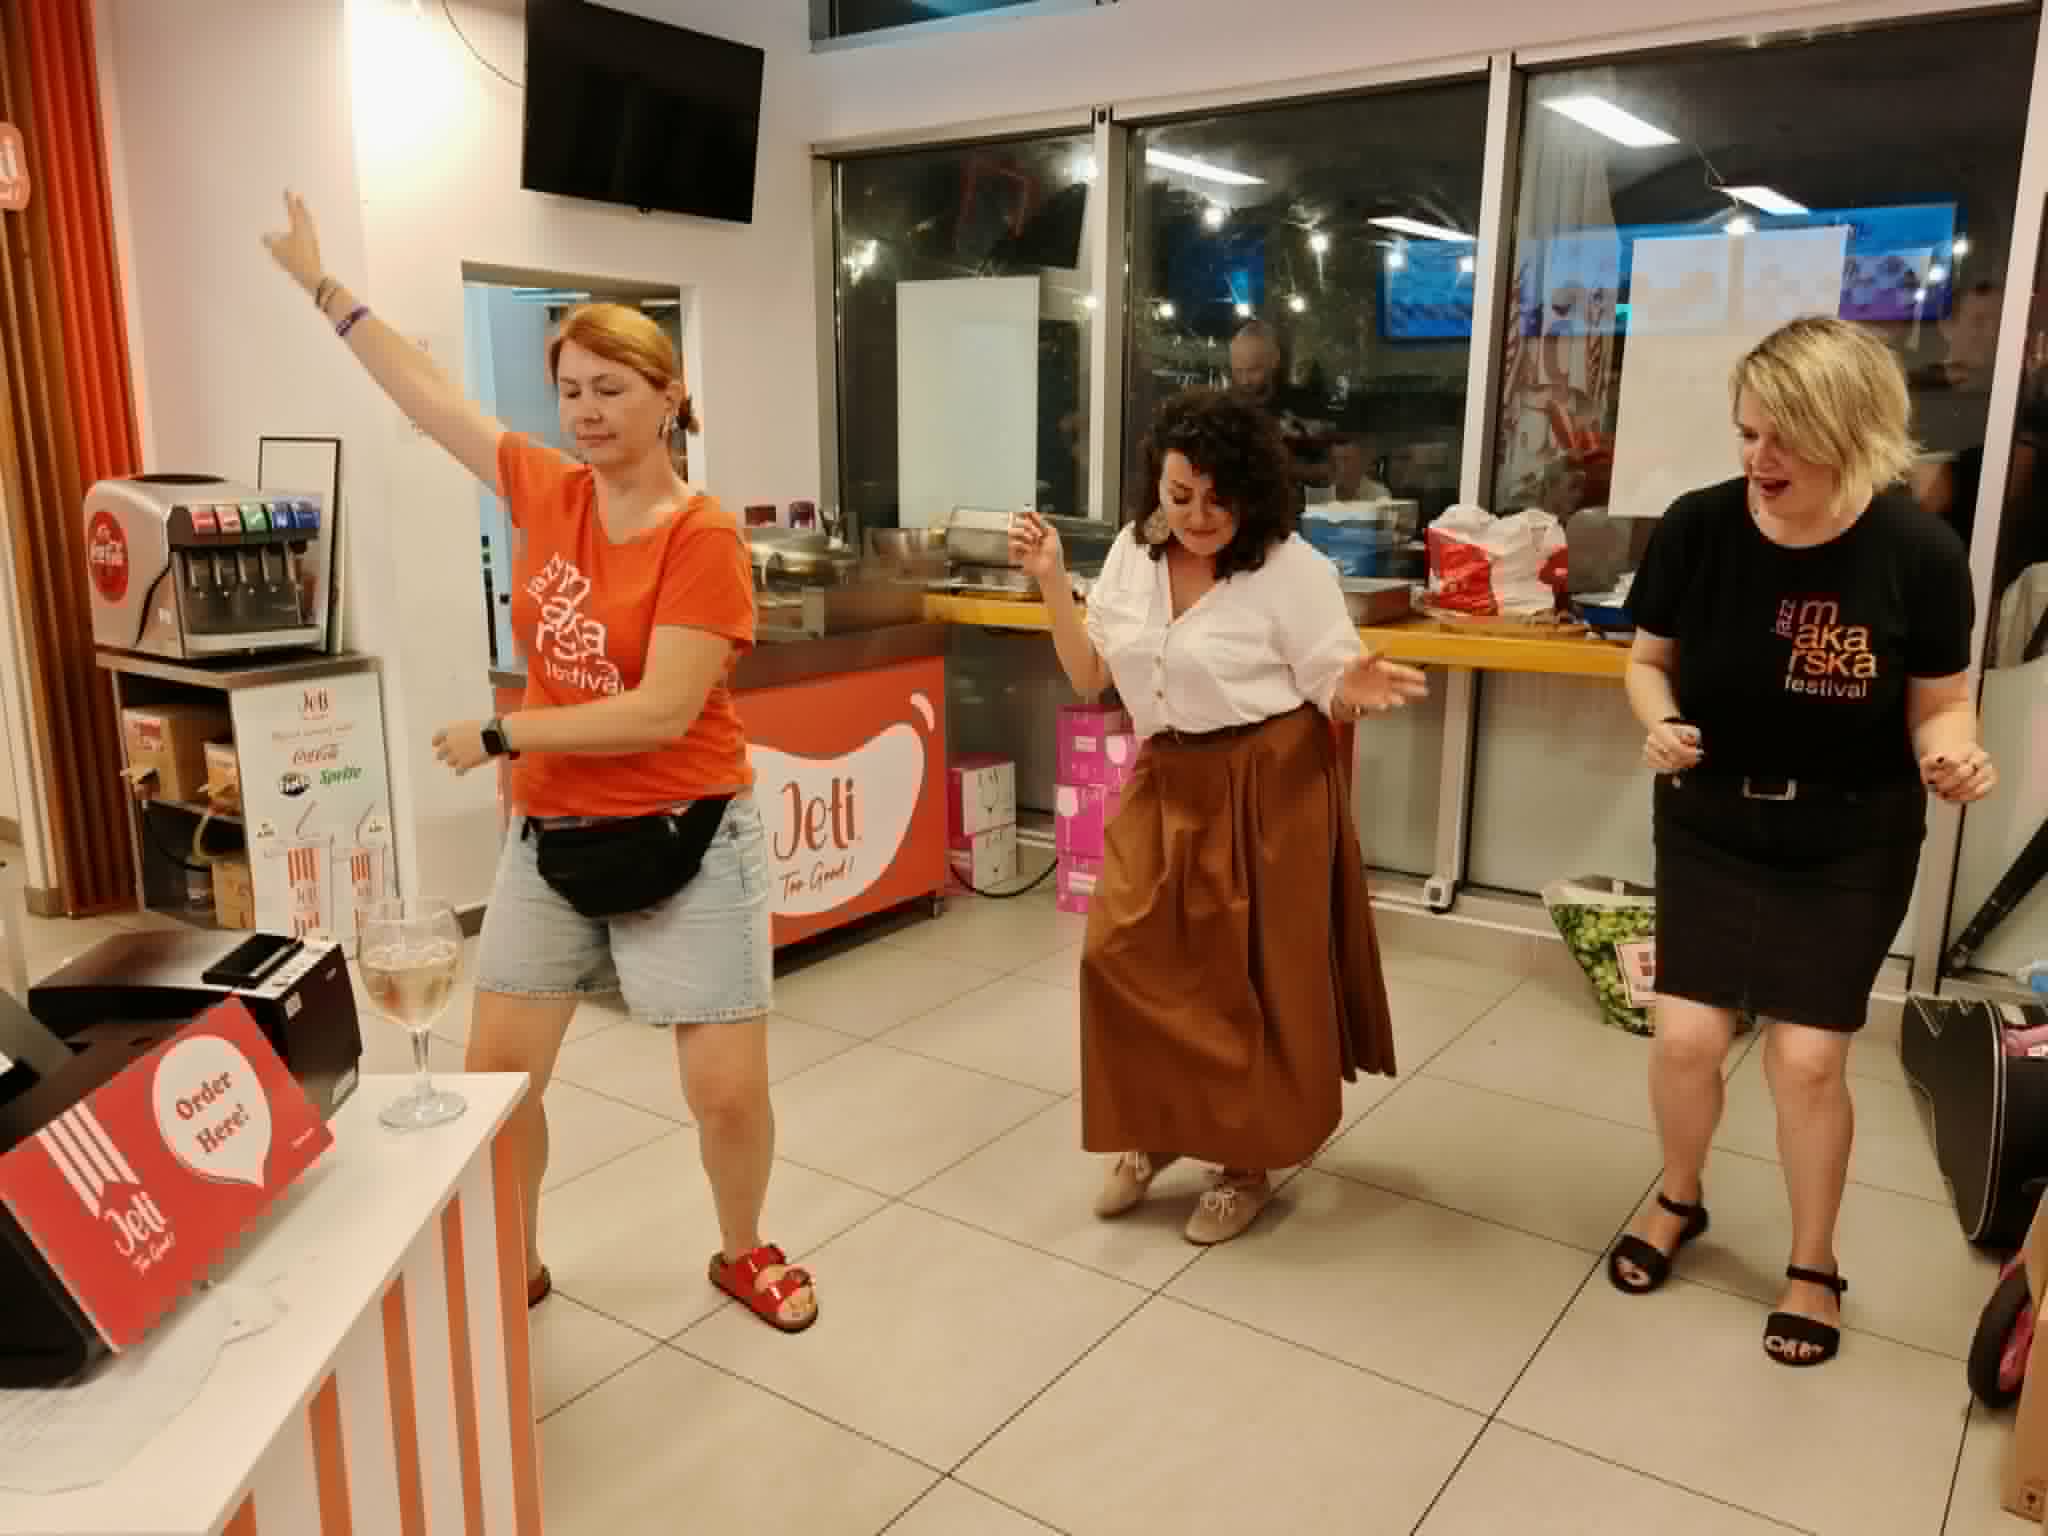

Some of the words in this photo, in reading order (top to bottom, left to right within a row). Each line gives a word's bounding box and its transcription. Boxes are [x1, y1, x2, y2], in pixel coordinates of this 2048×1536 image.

[1784, 674, 1868, 699] festival
[319, 765, 363, 786] Sprite
[774, 777, 856, 861] Jeti
[778, 870, 808, 903] Too
[175, 1071, 233, 1121] Order
[194, 1103, 250, 1154] Here!
[104, 1191, 169, 1257] Jeti
